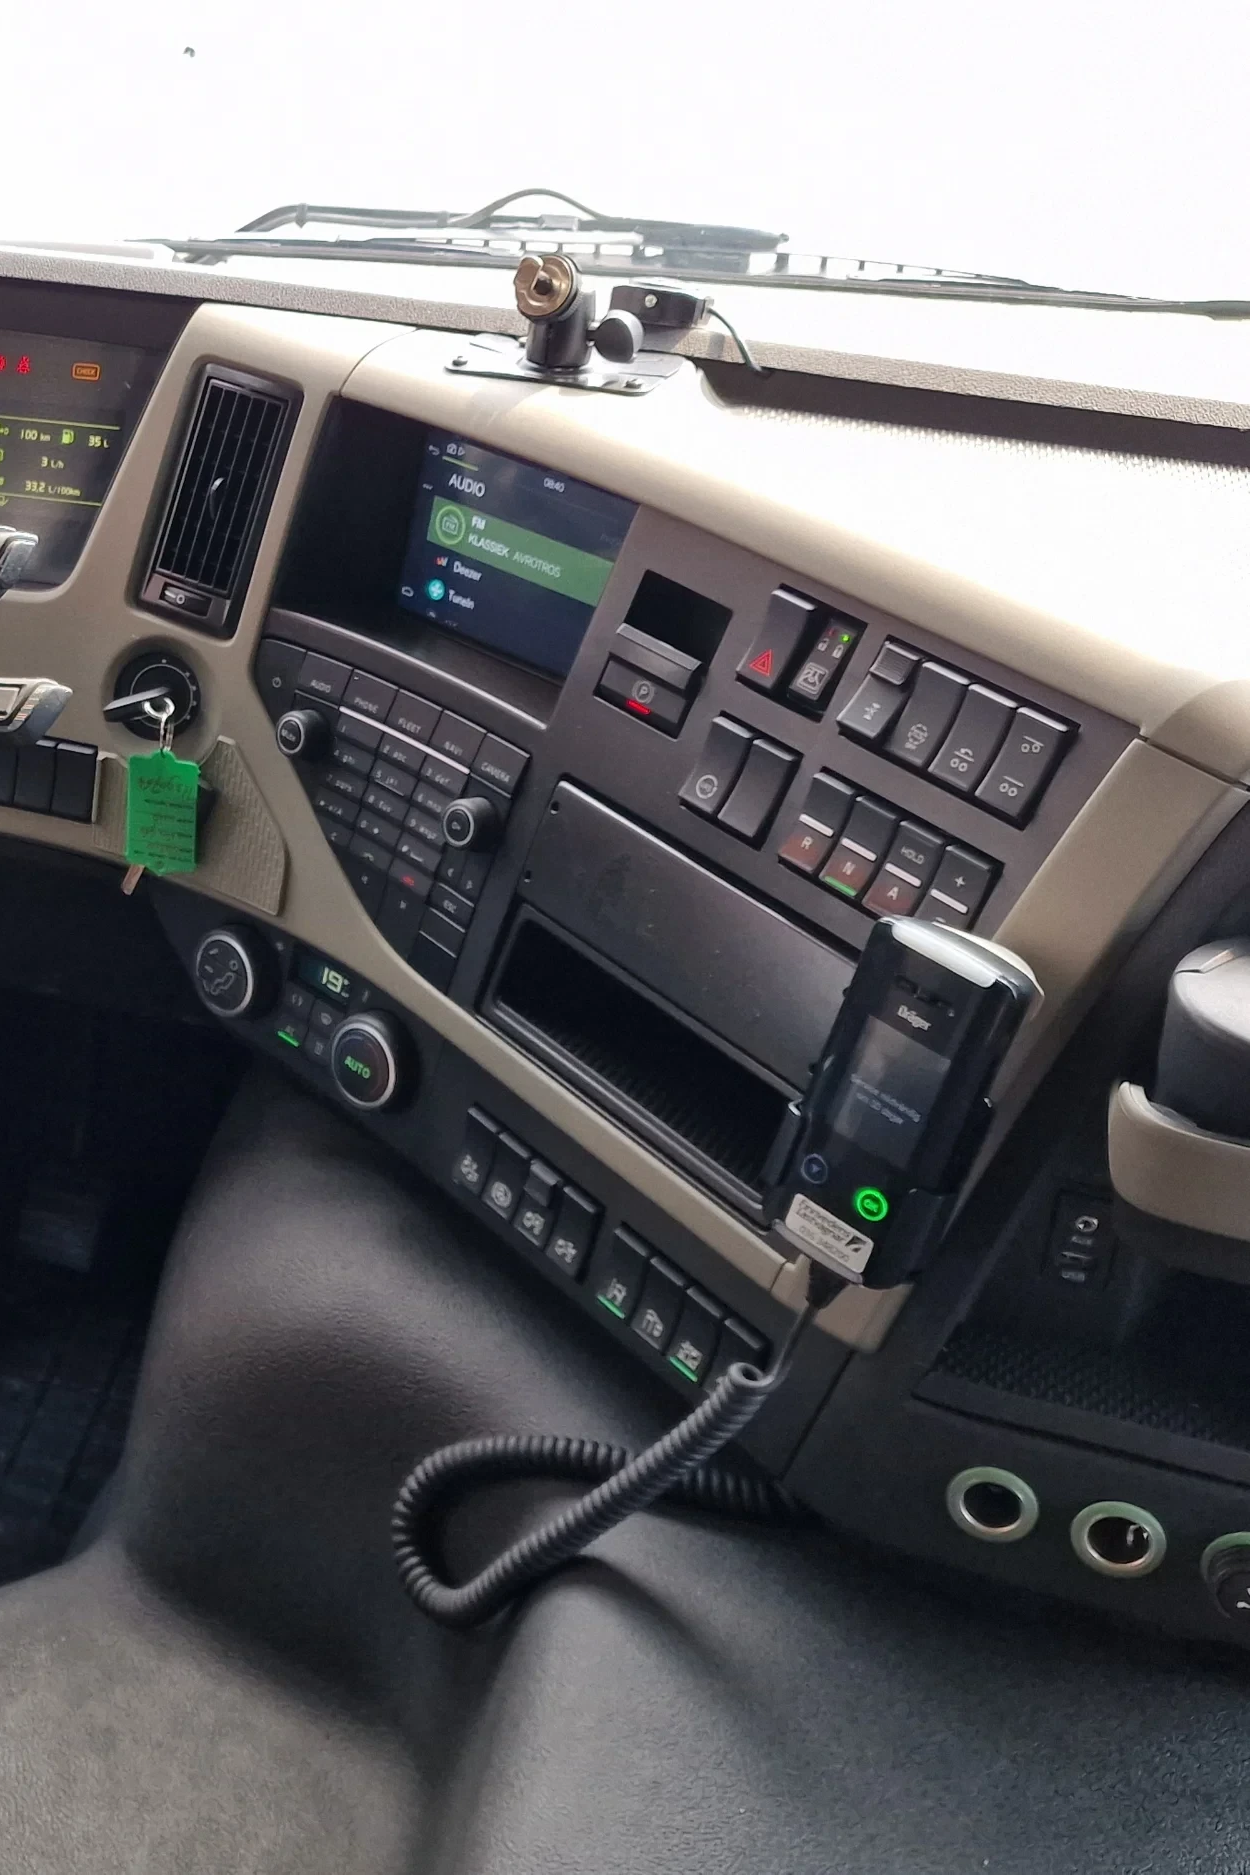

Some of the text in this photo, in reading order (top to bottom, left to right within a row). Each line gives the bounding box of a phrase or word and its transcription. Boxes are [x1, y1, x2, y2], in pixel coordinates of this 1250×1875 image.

[76, 367, 95, 376] CHECK
[21, 428, 50, 441] 100 km
[88, 435, 101, 447] 35
[41, 456, 48, 467] 3
[448, 473, 486, 498] AUDIO
[472, 515, 486, 530] FM
[468, 533, 561, 578] KLASSIEK AVROTROS
[453, 561, 482, 581] Deezer
[310, 679, 331, 693] AUDIO
[354, 697, 379, 714] PHONE
[397, 717, 422, 734] FLEET
[480, 762, 510, 783] CAMERA
[801, 836, 814, 850] R
[901, 846, 925, 865] HOLD
[842, 861, 856, 876] N
[887, 886, 899, 900] A
[897, 1004, 932, 1031] Dräger
[344, 1055, 371, 1079] AUTO
